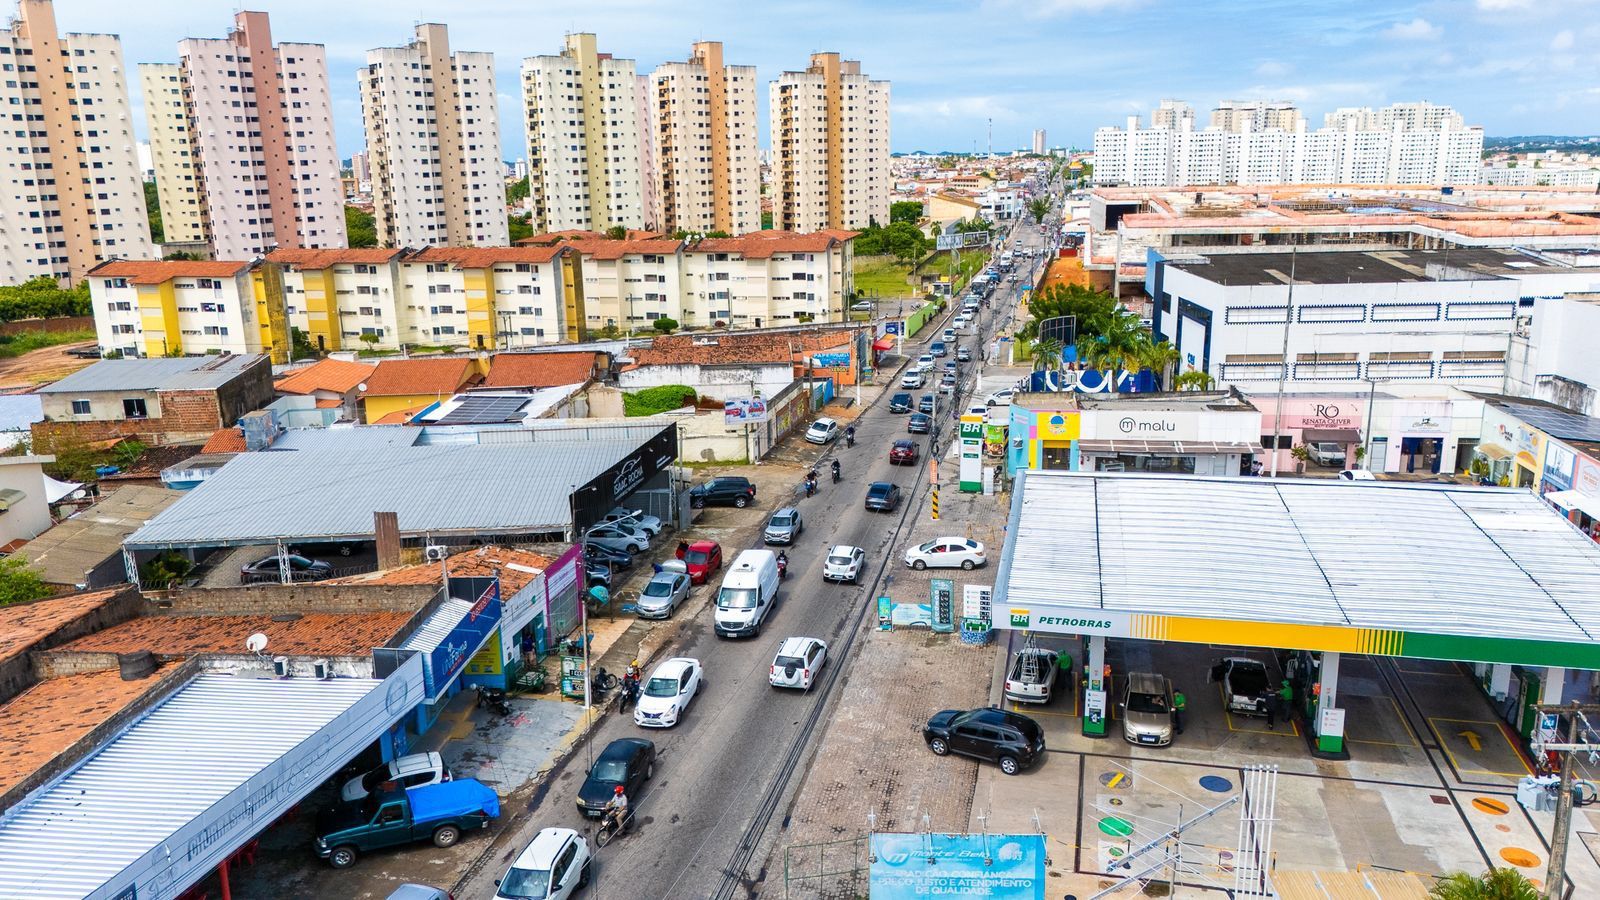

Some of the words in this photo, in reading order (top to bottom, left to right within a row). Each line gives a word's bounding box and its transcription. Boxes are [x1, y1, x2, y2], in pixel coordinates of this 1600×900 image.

[1316, 404, 1340, 419] RO
[963, 423, 981, 433] BR
[1139, 419, 1176, 432] malu
[1012, 614, 1028, 623] BR
[1039, 616, 1112, 629] PETROBRAS
[913, 879, 948, 887] JUSTO
[950, 879, 957, 887] E
[959, 879, 1032, 888] ATENDIMENTO
[915, 886, 930, 895] DE
